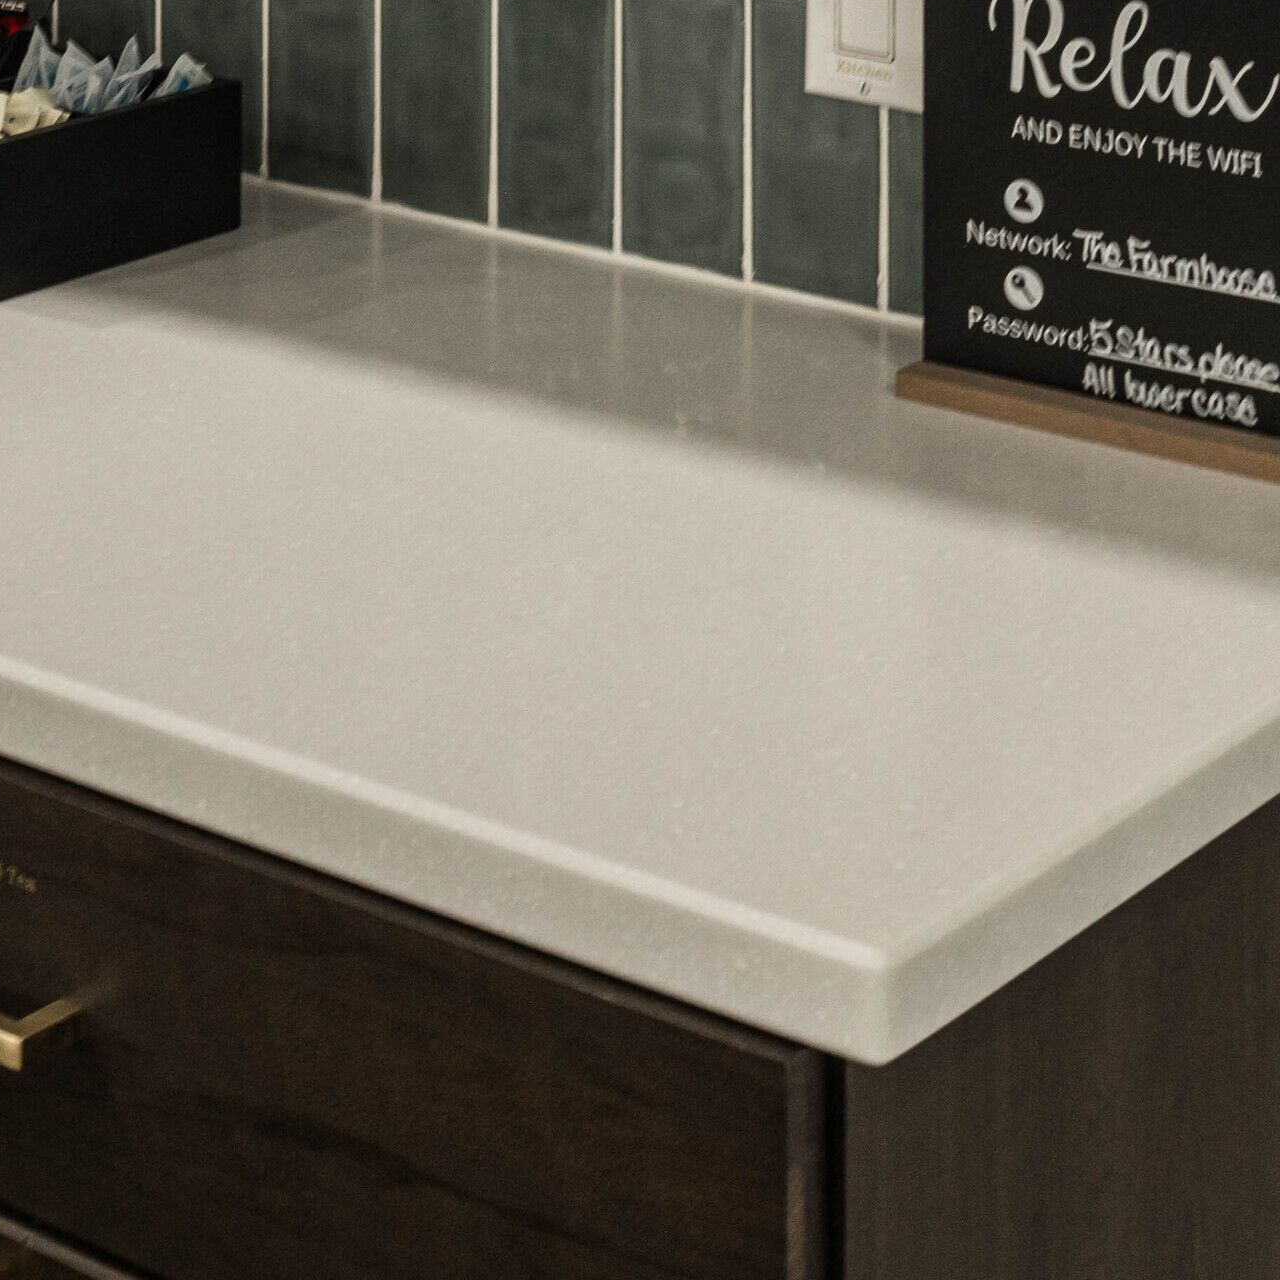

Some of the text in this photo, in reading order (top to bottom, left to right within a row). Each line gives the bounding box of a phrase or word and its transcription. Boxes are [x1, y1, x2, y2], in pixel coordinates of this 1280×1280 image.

[1011, 115, 1263, 179] AND ENJOY THE WIFI
[966, 218, 1071, 262] Network:
[1072, 228, 1124, 268] The
[1082, 361, 1116, 399] All
